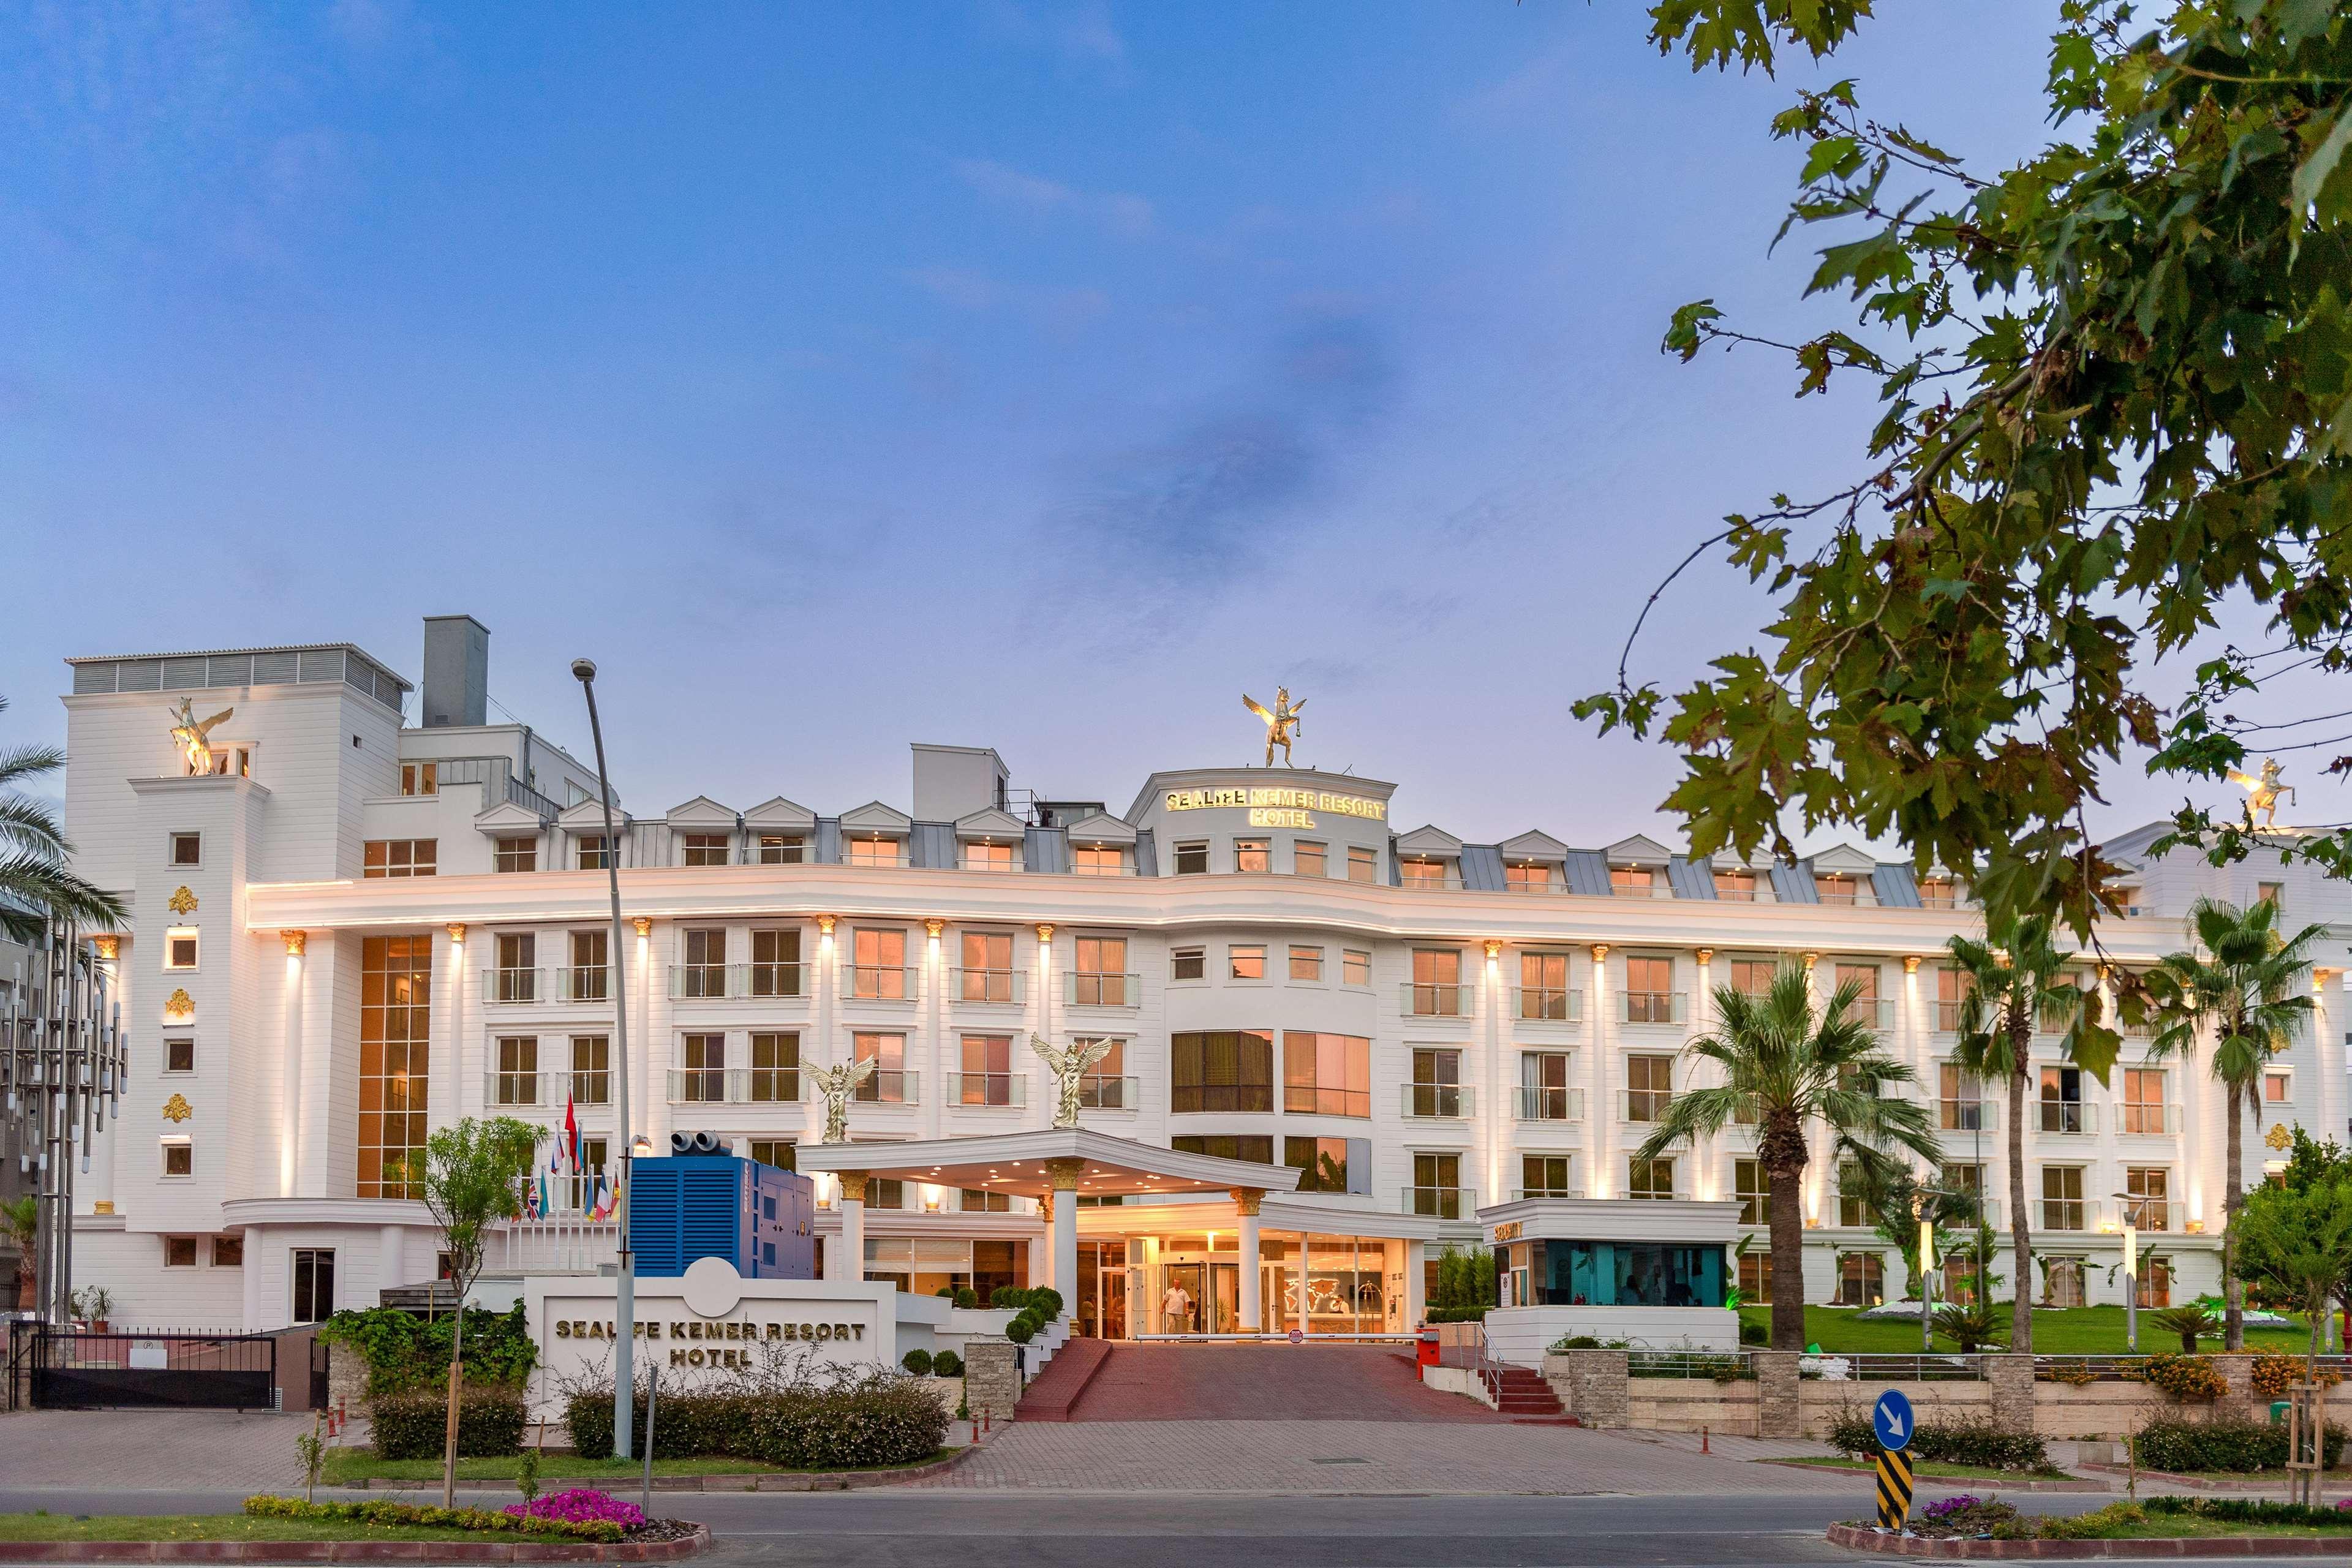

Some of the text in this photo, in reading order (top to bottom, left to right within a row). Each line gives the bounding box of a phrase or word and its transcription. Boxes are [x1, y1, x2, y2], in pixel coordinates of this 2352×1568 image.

[1167, 790, 1384, 819] SEALIFE KEMER RESORT
[1253, 810, 1314, 827] HOTEL
[1494, 1221, 1523, 1242] SECURITY
[556, 1320, 865, 1340] SEALFE KEMER RESORT
[670, 1349, 753, 1367] HOTEL
